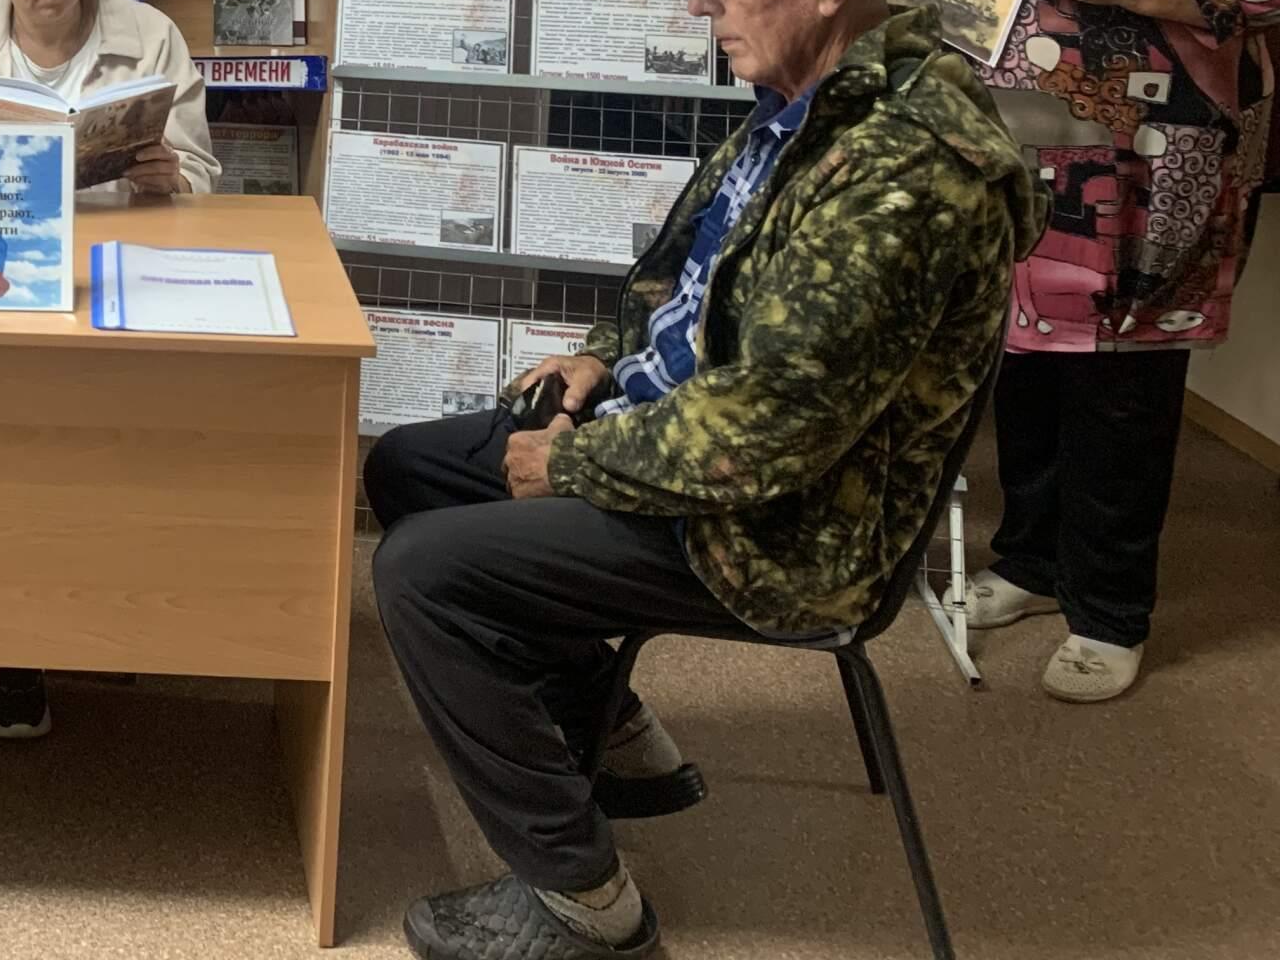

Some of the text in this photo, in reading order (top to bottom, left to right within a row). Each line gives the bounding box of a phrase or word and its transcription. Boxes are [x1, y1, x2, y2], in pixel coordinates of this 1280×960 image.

[211, 61, 291, 82] ВРЕМЕНИ
[549, 153, 580, 164] Война
[589, 156, 625, 168] Южной
[627, 159, 662, 170] Осетии
[367, 313, 455, 329] Пражская весна
[525, 326, 586, 340] Разминирован
